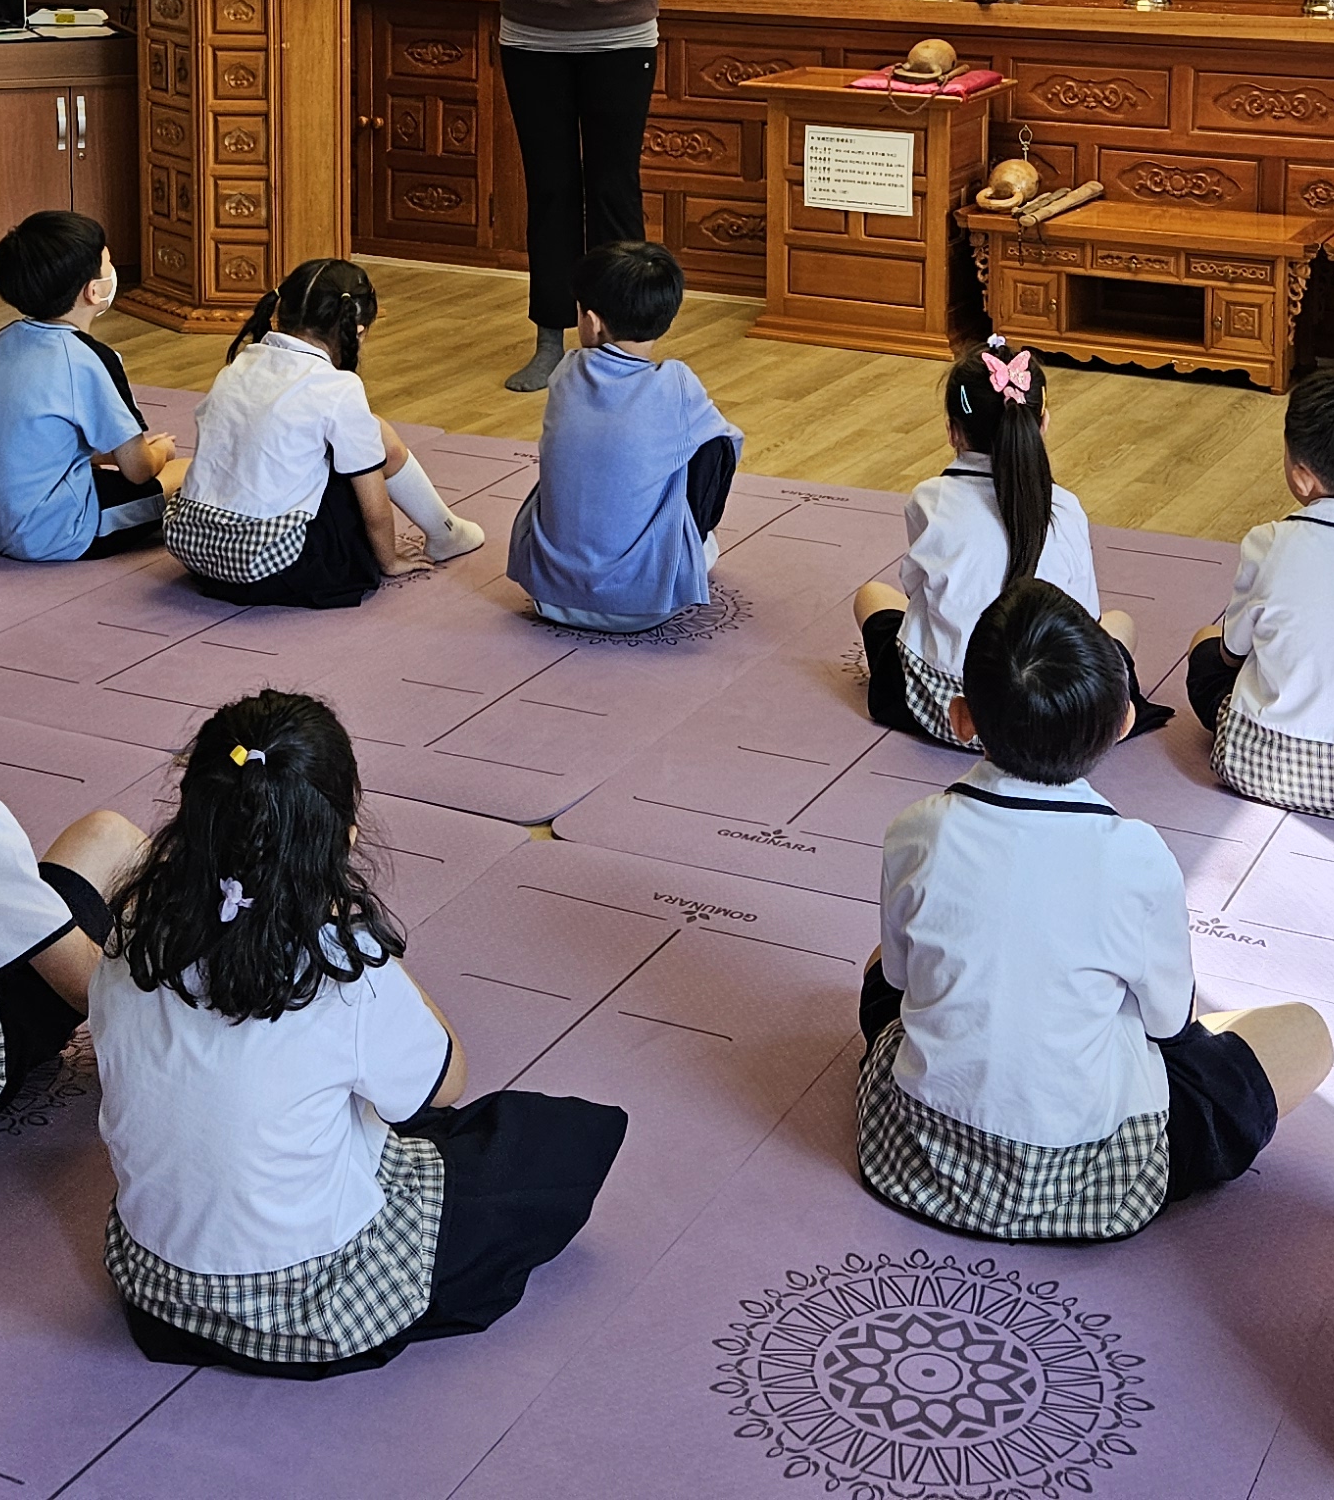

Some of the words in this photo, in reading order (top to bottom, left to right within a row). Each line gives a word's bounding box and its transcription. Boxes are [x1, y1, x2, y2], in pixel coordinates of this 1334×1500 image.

[718, 829, 816, 853] GOMUNARA
[653, 892, 758, 922] GOMUNARA
[1189, 924, 1266, 947] UNARA
